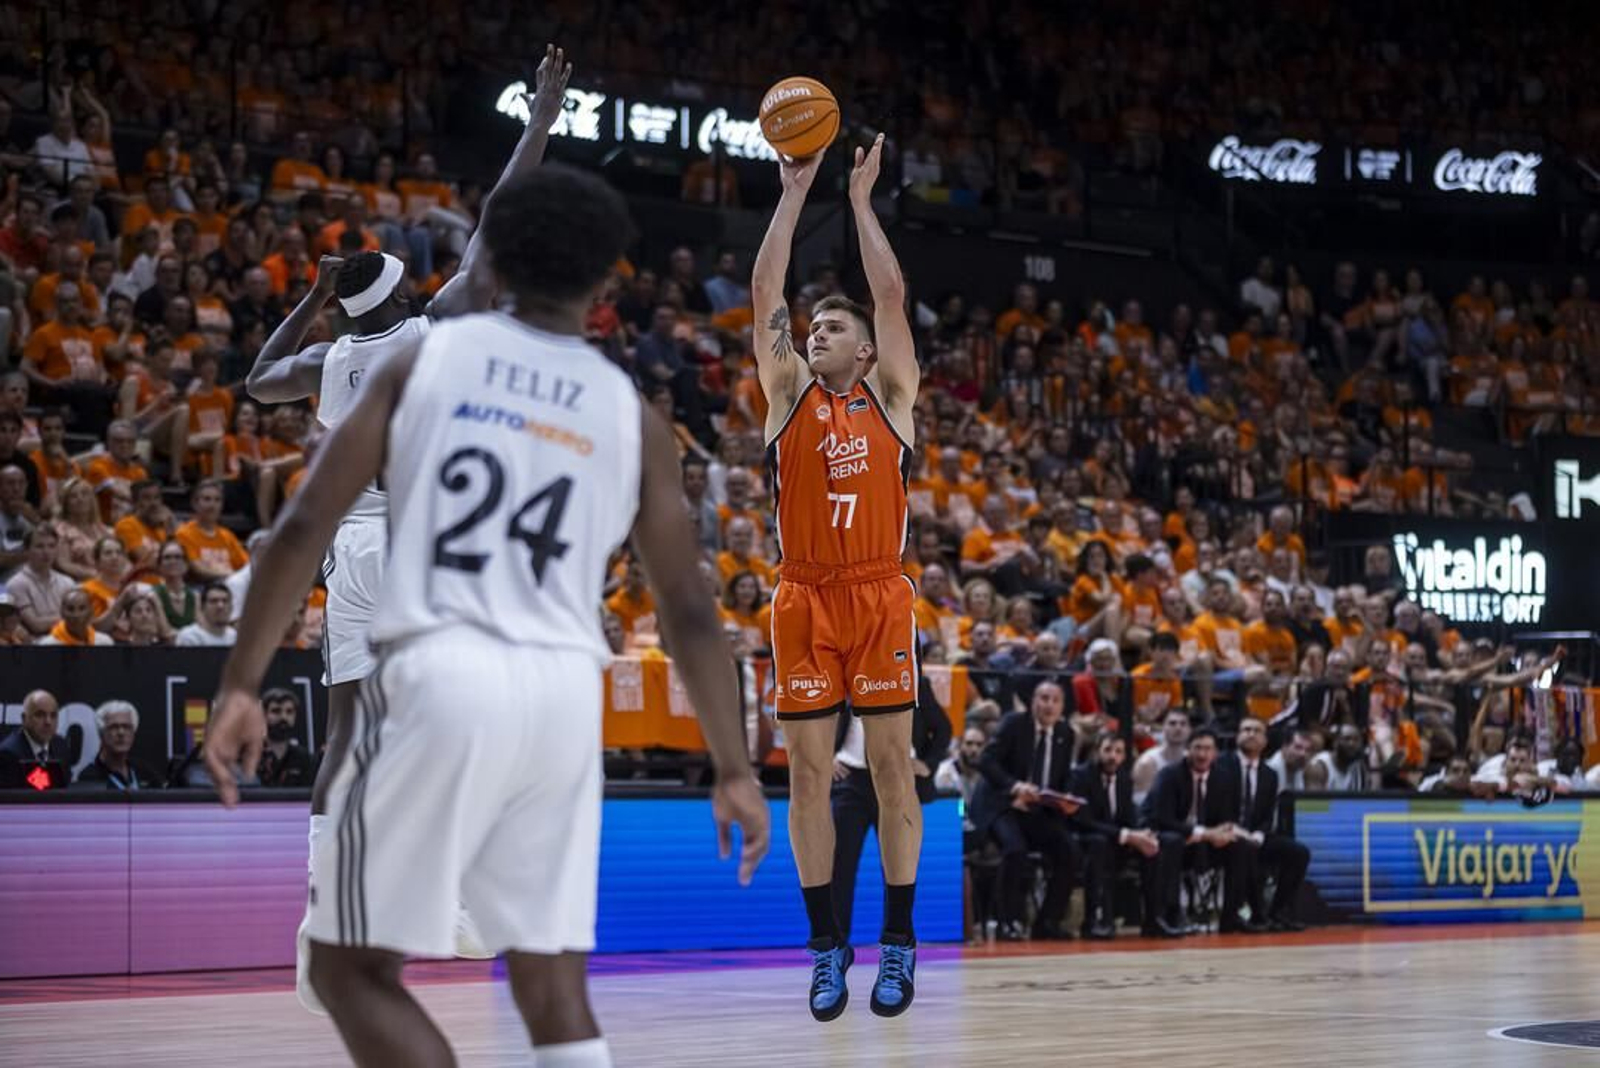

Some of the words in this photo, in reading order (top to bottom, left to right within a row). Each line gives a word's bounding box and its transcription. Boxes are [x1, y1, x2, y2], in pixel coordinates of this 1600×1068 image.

[762, 87, 811, 112] Wilson
[1434, 148, 1542, 196] Coca-Cola
[486, 357, 586, 411] FELIZ
[829, 459, 870, 480] RENA
[433, 447, 574, 587] 24
[827, 492, 858, 528] 77
[791, 679, 828, 690] PULEV
[1414, 829, 1537, 898] Viajar
